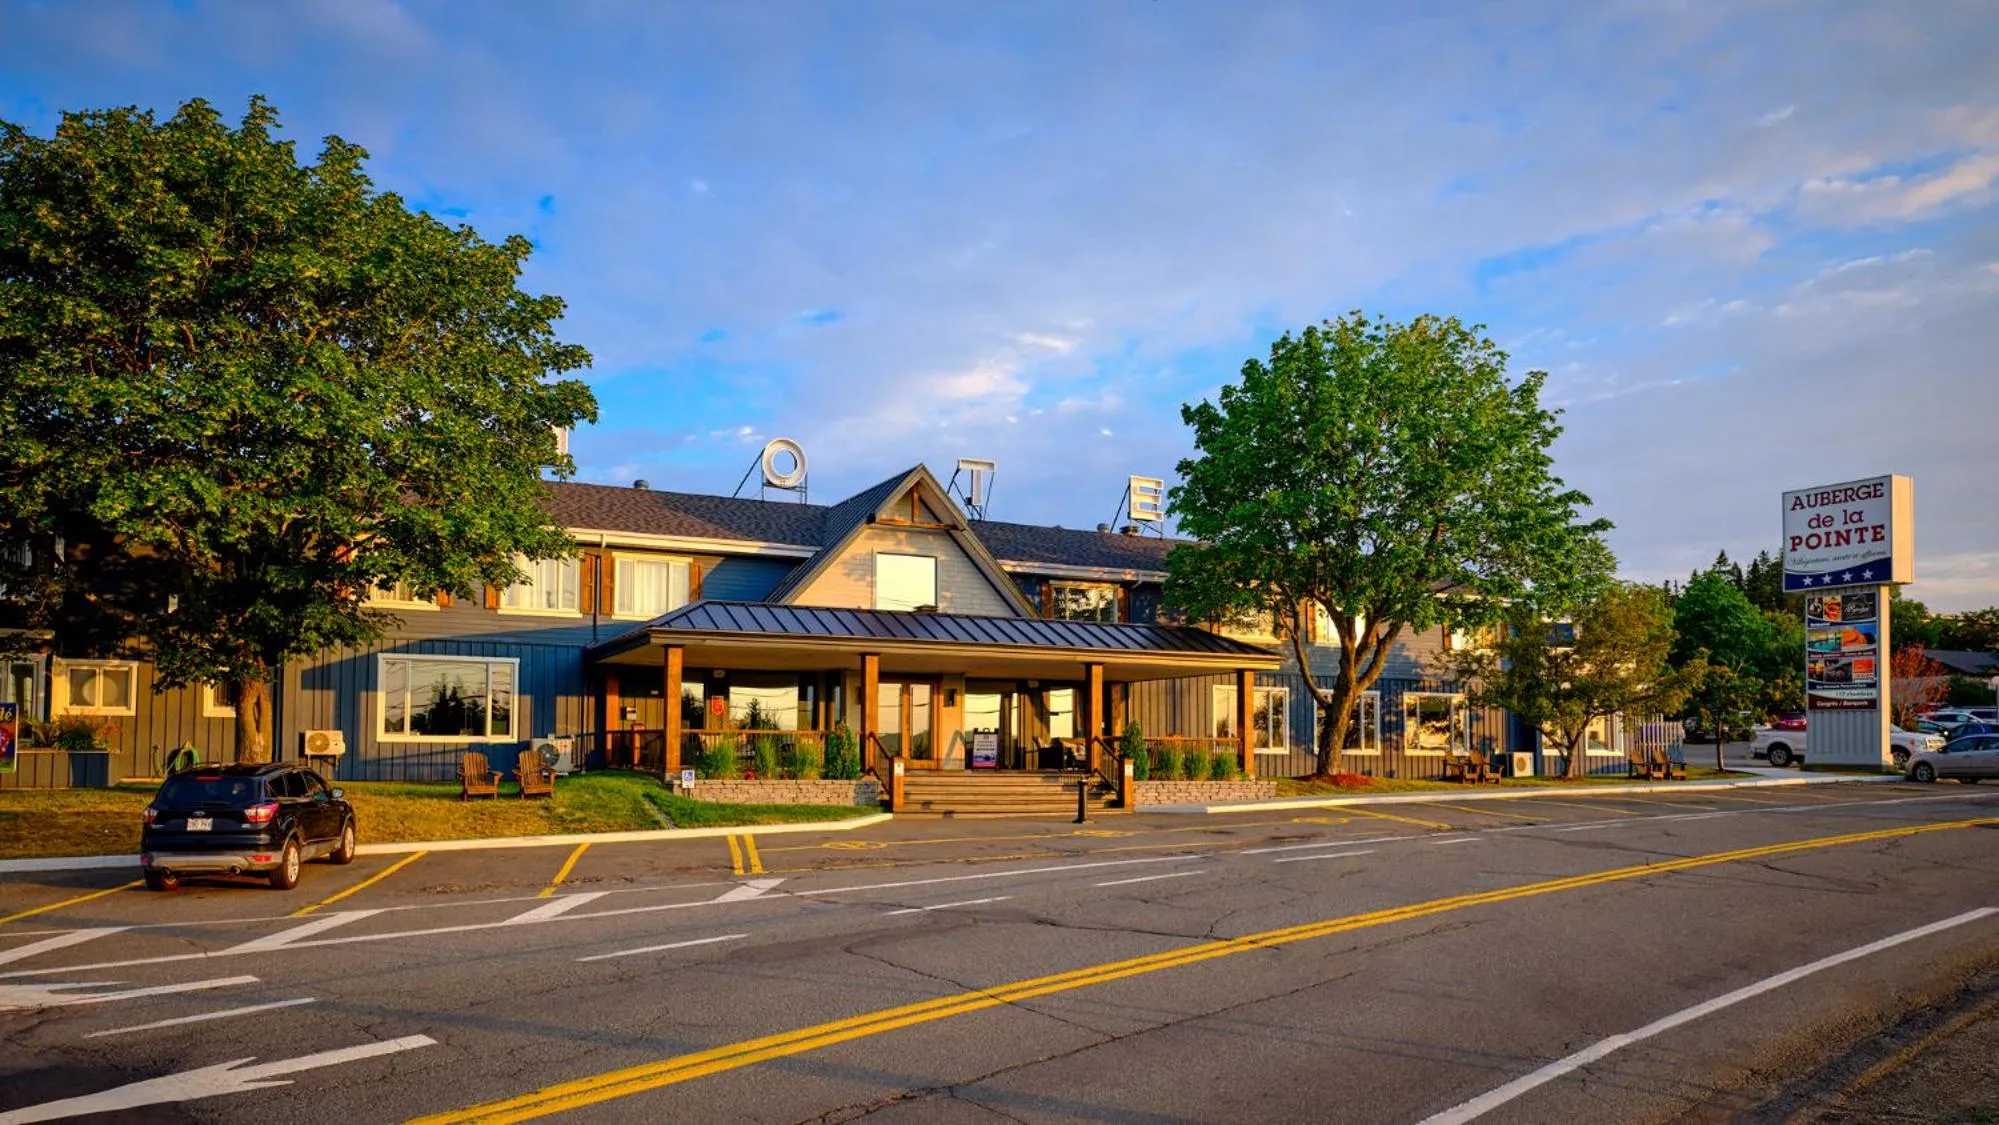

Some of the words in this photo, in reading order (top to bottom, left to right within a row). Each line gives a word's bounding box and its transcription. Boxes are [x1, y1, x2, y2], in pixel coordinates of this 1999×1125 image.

[1790, 482, 1885, 511] AUBERGE
[1807, 513, 1835, 529] de
[1842, 508, 1865, 525] la
[1789, 524, 1886, 552] POINTE
